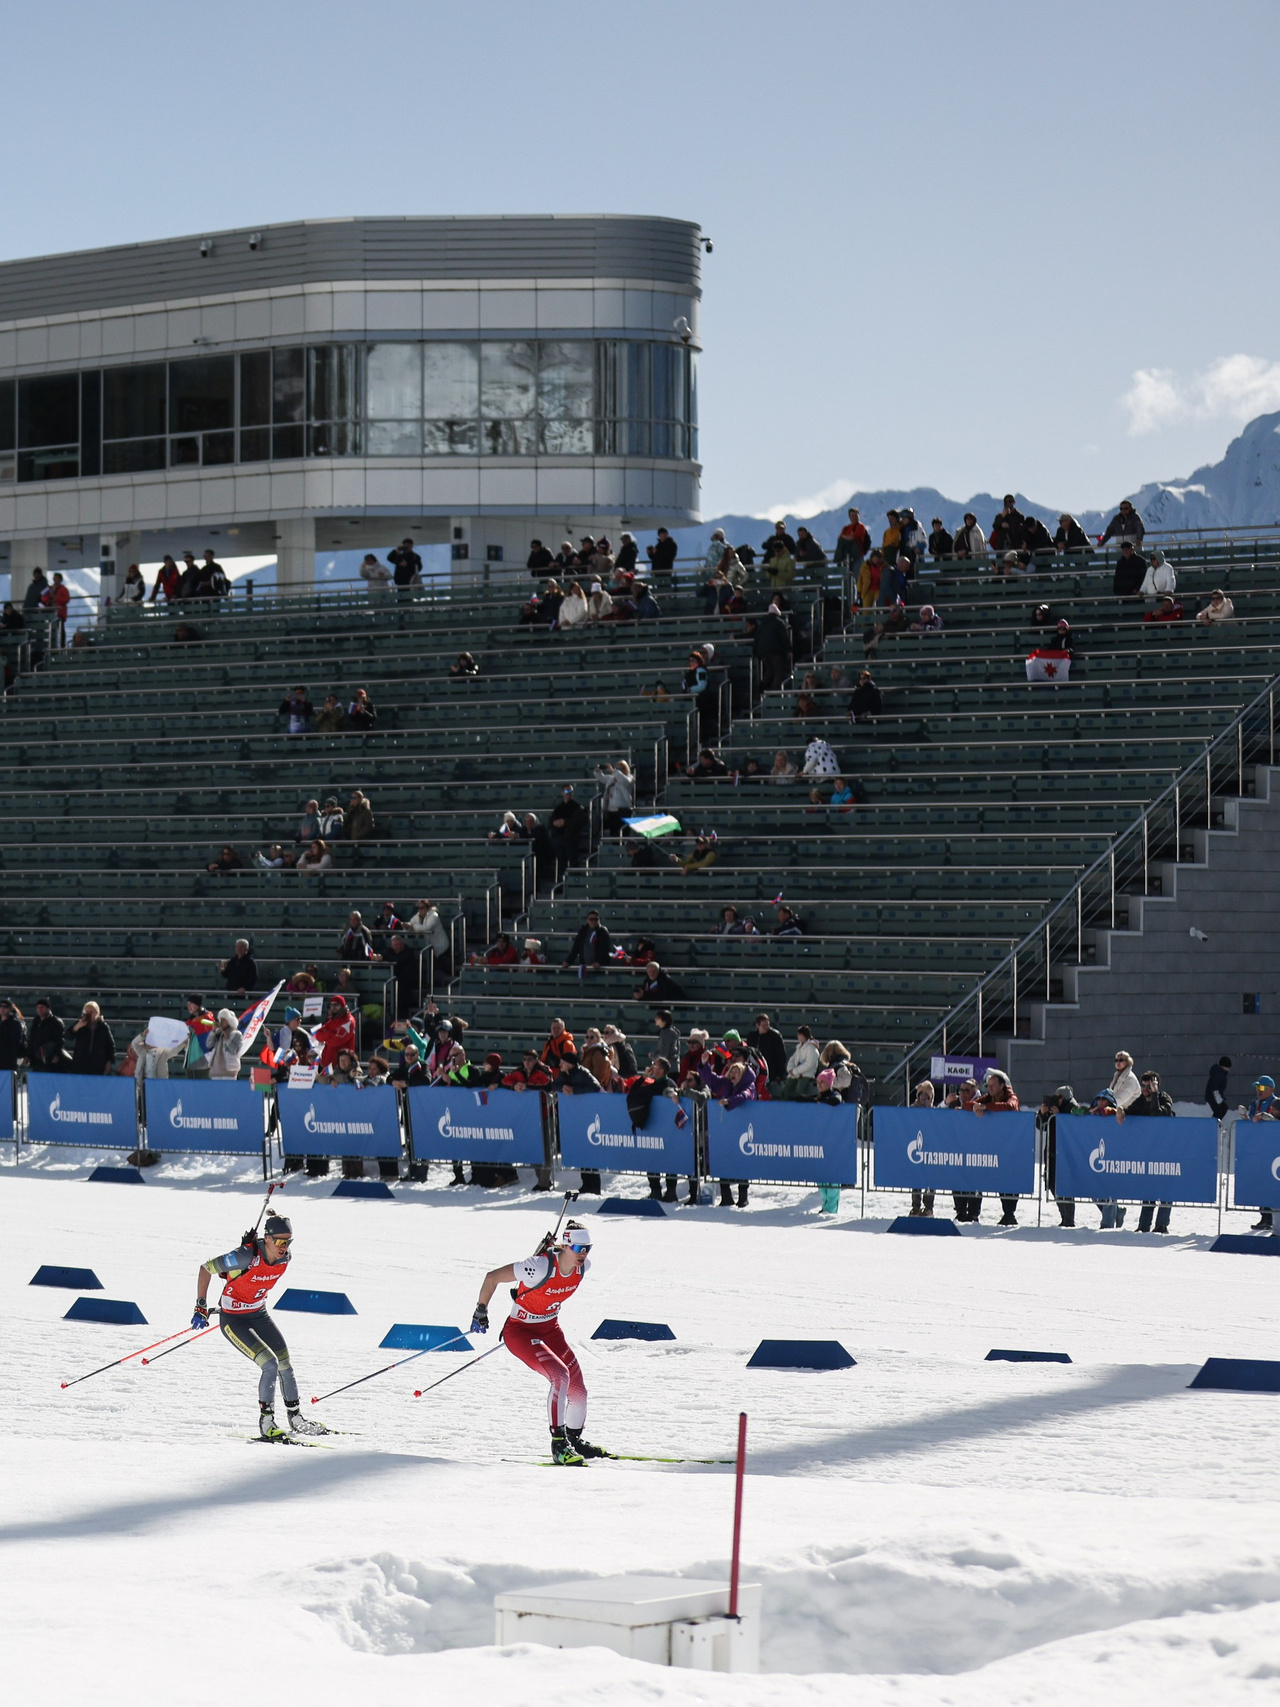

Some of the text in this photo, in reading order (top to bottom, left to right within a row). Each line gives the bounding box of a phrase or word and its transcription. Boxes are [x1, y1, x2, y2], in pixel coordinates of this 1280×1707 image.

[947, 1066, 971, 1075] КАФЕ
[60, 1110, 87, 1123] ГАЗПРОМ
[183, 1116, 211, 1129] ГАЗПРОМ
[317, 1121, 374, 1135] ГАЗПРОМ ПОЛЯНА
[452, 1126, 514, 1141] ГАЗПРОМ ПОЛЯНА
[601, 1133, 664, 1150] ГАЗПРОМ ПОЛЯНА
[754, 1143, 824, 1159] ГАЗПРОМ ПОЛЯНА
[924, 1151, 998, 1168] ГАЗПРОМ ПОЛЯНА
[1106, 1160, 1181, 1176] ГАЗПРОМ ПОЛЯНА
[226, 1287, 233, 1295] 2
